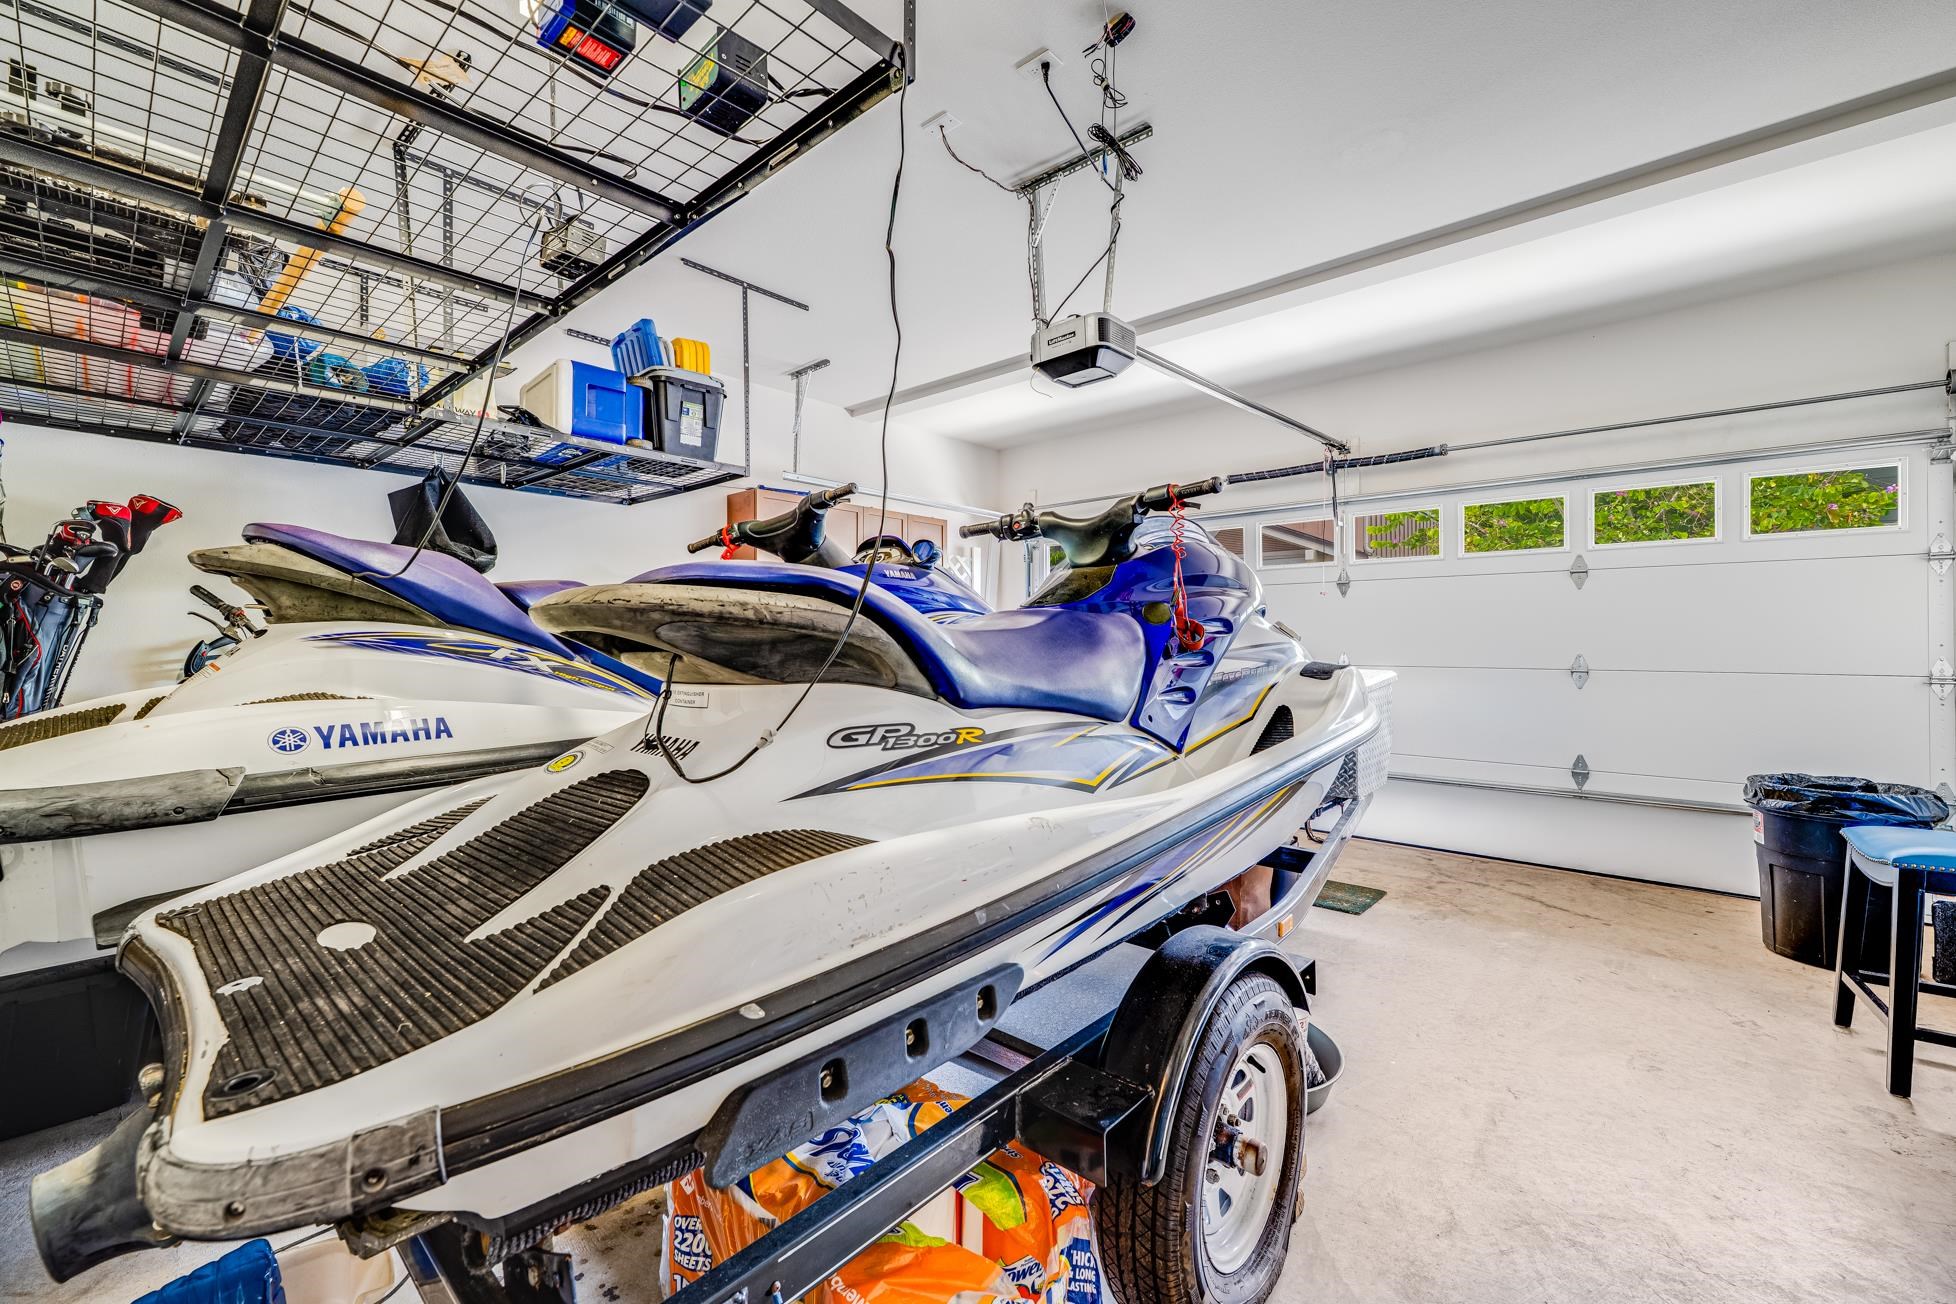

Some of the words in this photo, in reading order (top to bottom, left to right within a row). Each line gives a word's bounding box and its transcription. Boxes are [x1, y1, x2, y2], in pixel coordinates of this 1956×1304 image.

[884, 569, 917, 580] YAMAHA
[313, 717, 453, 750] YAMAHA
[630, 733, 701, 761] YAHA
[674, 1249, 712, 1272] SHEETS
[1070, 1249, 1097, 1269] HICK
[1076, 1268, 1097, 1282] LONG
